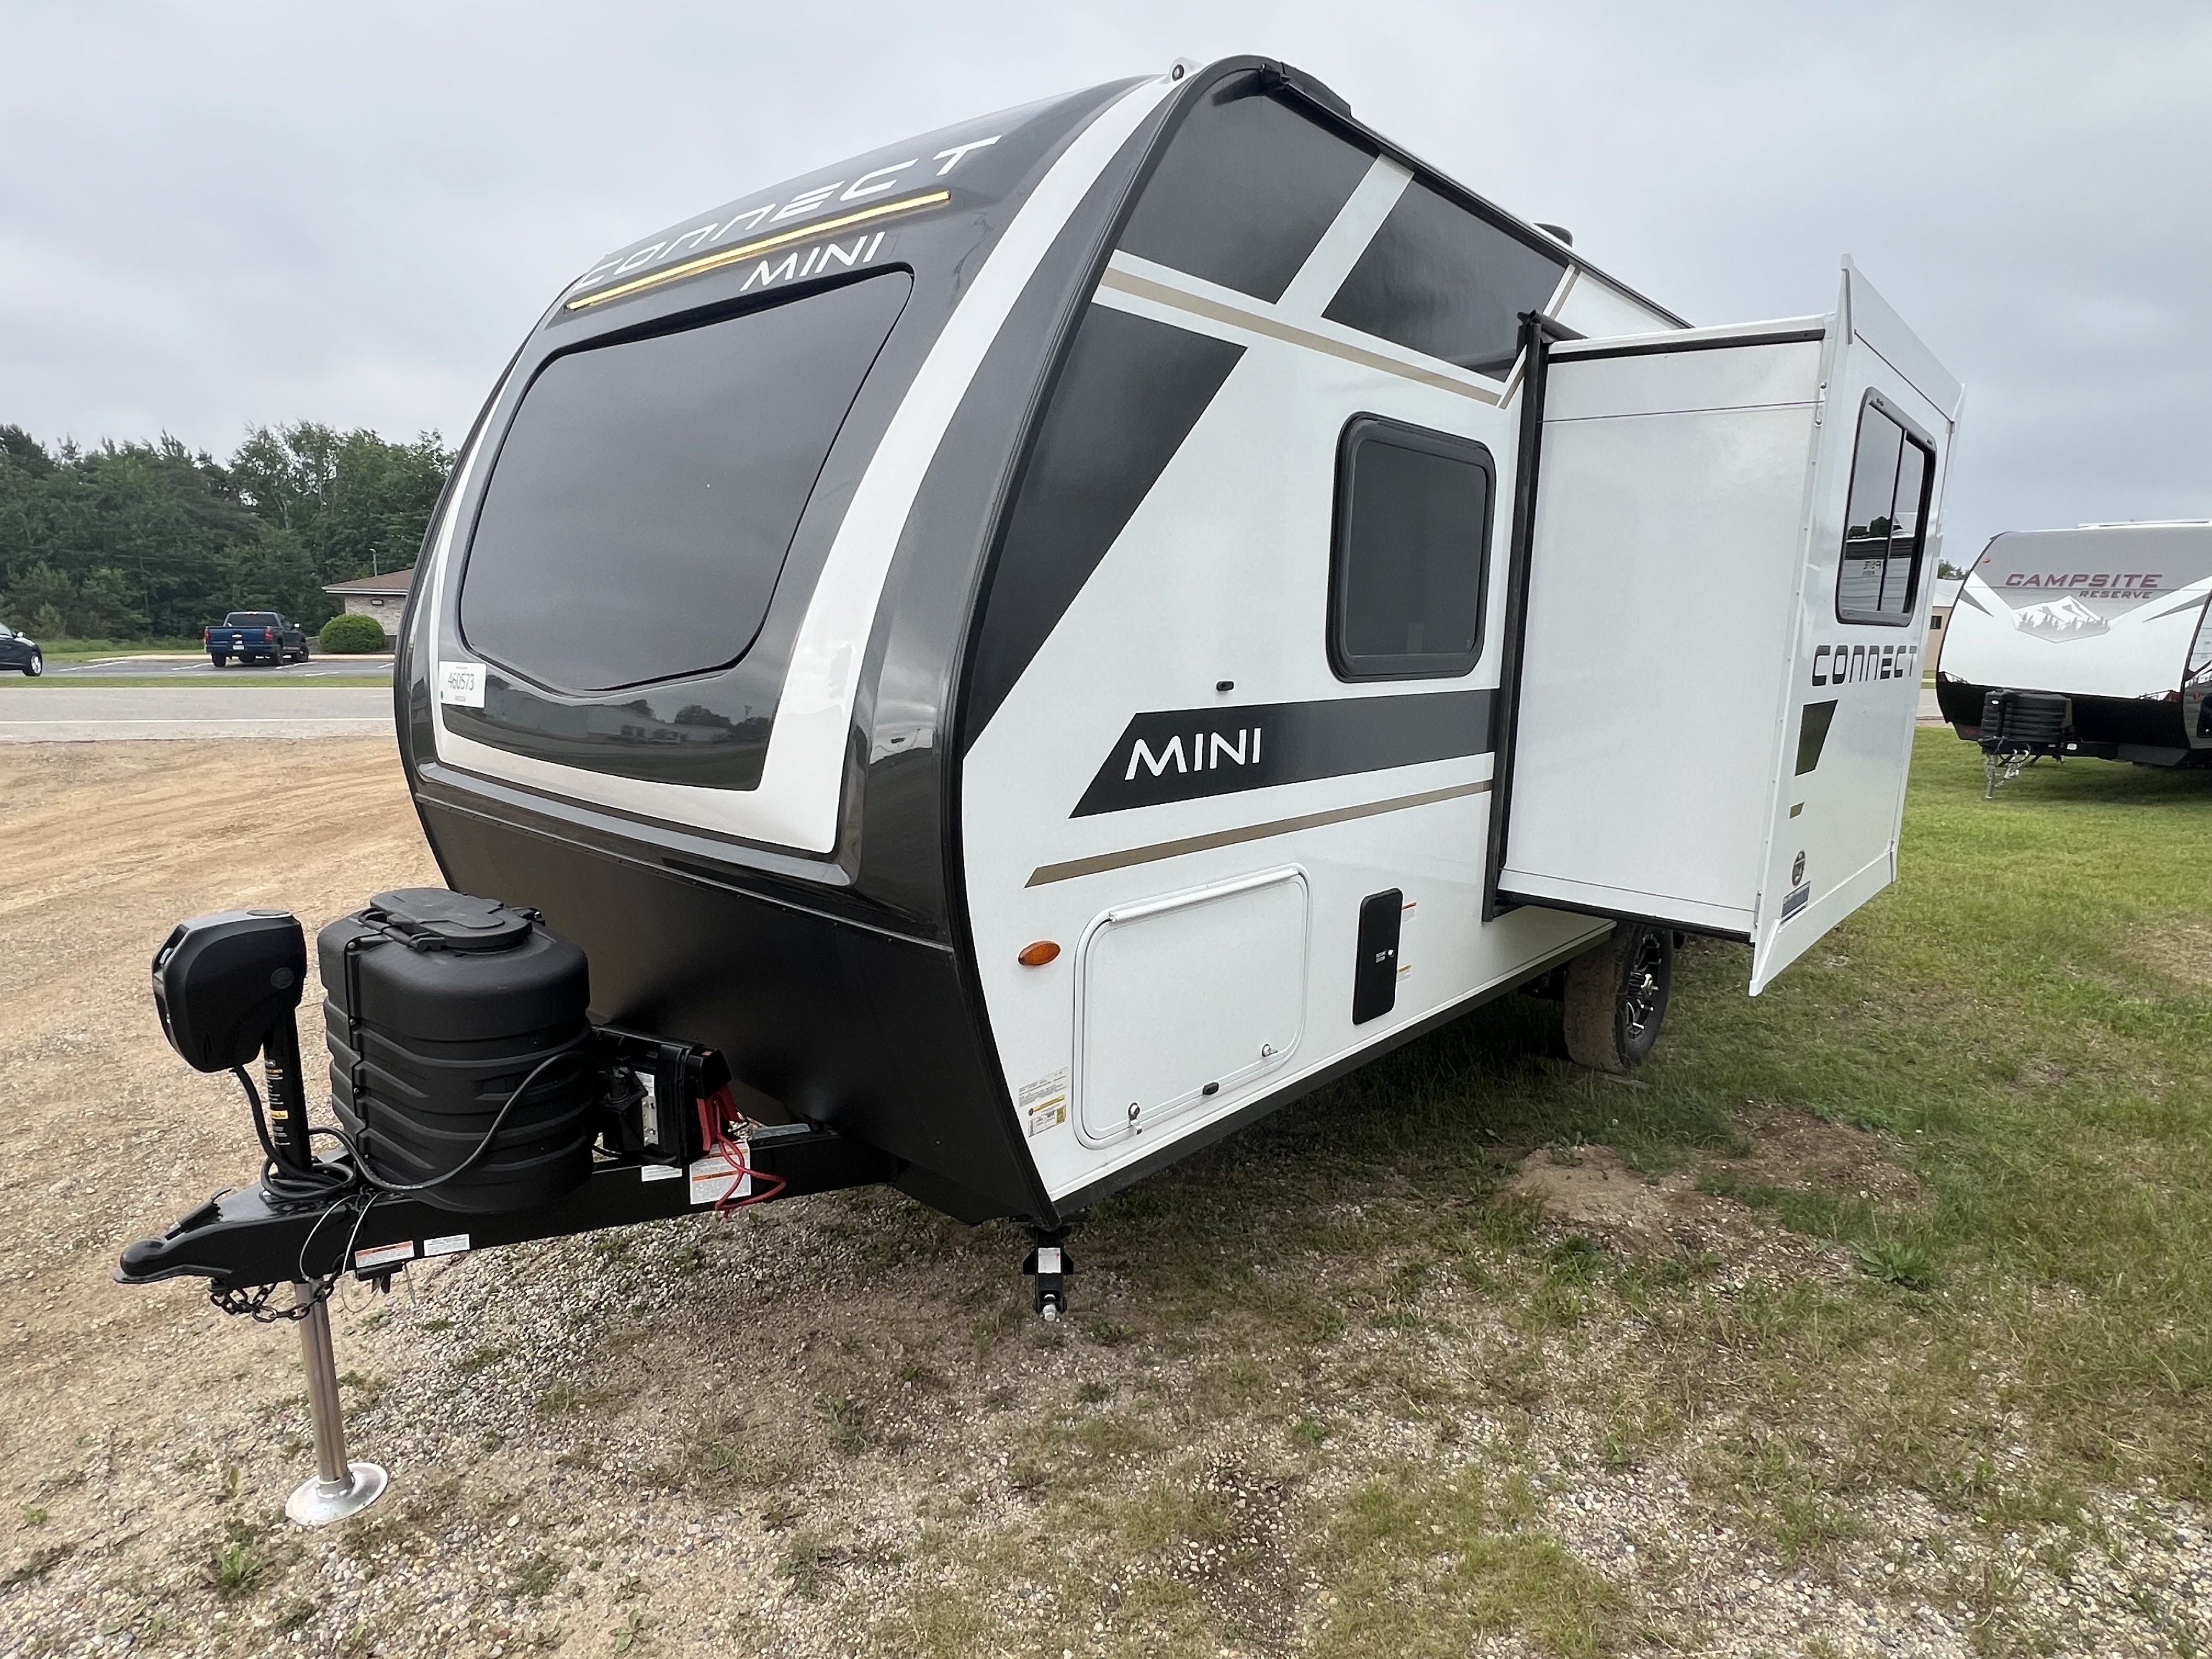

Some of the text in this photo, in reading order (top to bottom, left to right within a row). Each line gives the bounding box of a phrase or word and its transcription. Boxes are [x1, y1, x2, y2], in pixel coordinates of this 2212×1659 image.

[573, 135, 1002, 292] CONNECT
[740, 232, 886, 291] MINI
[2006, 574, 2163, 588] CAMPSITE
[2079, 590, 2154, 599] RESERVE
[1812, 645, 1917, 687] CONNECT
[1124, 727, 1262, 780] MINI
